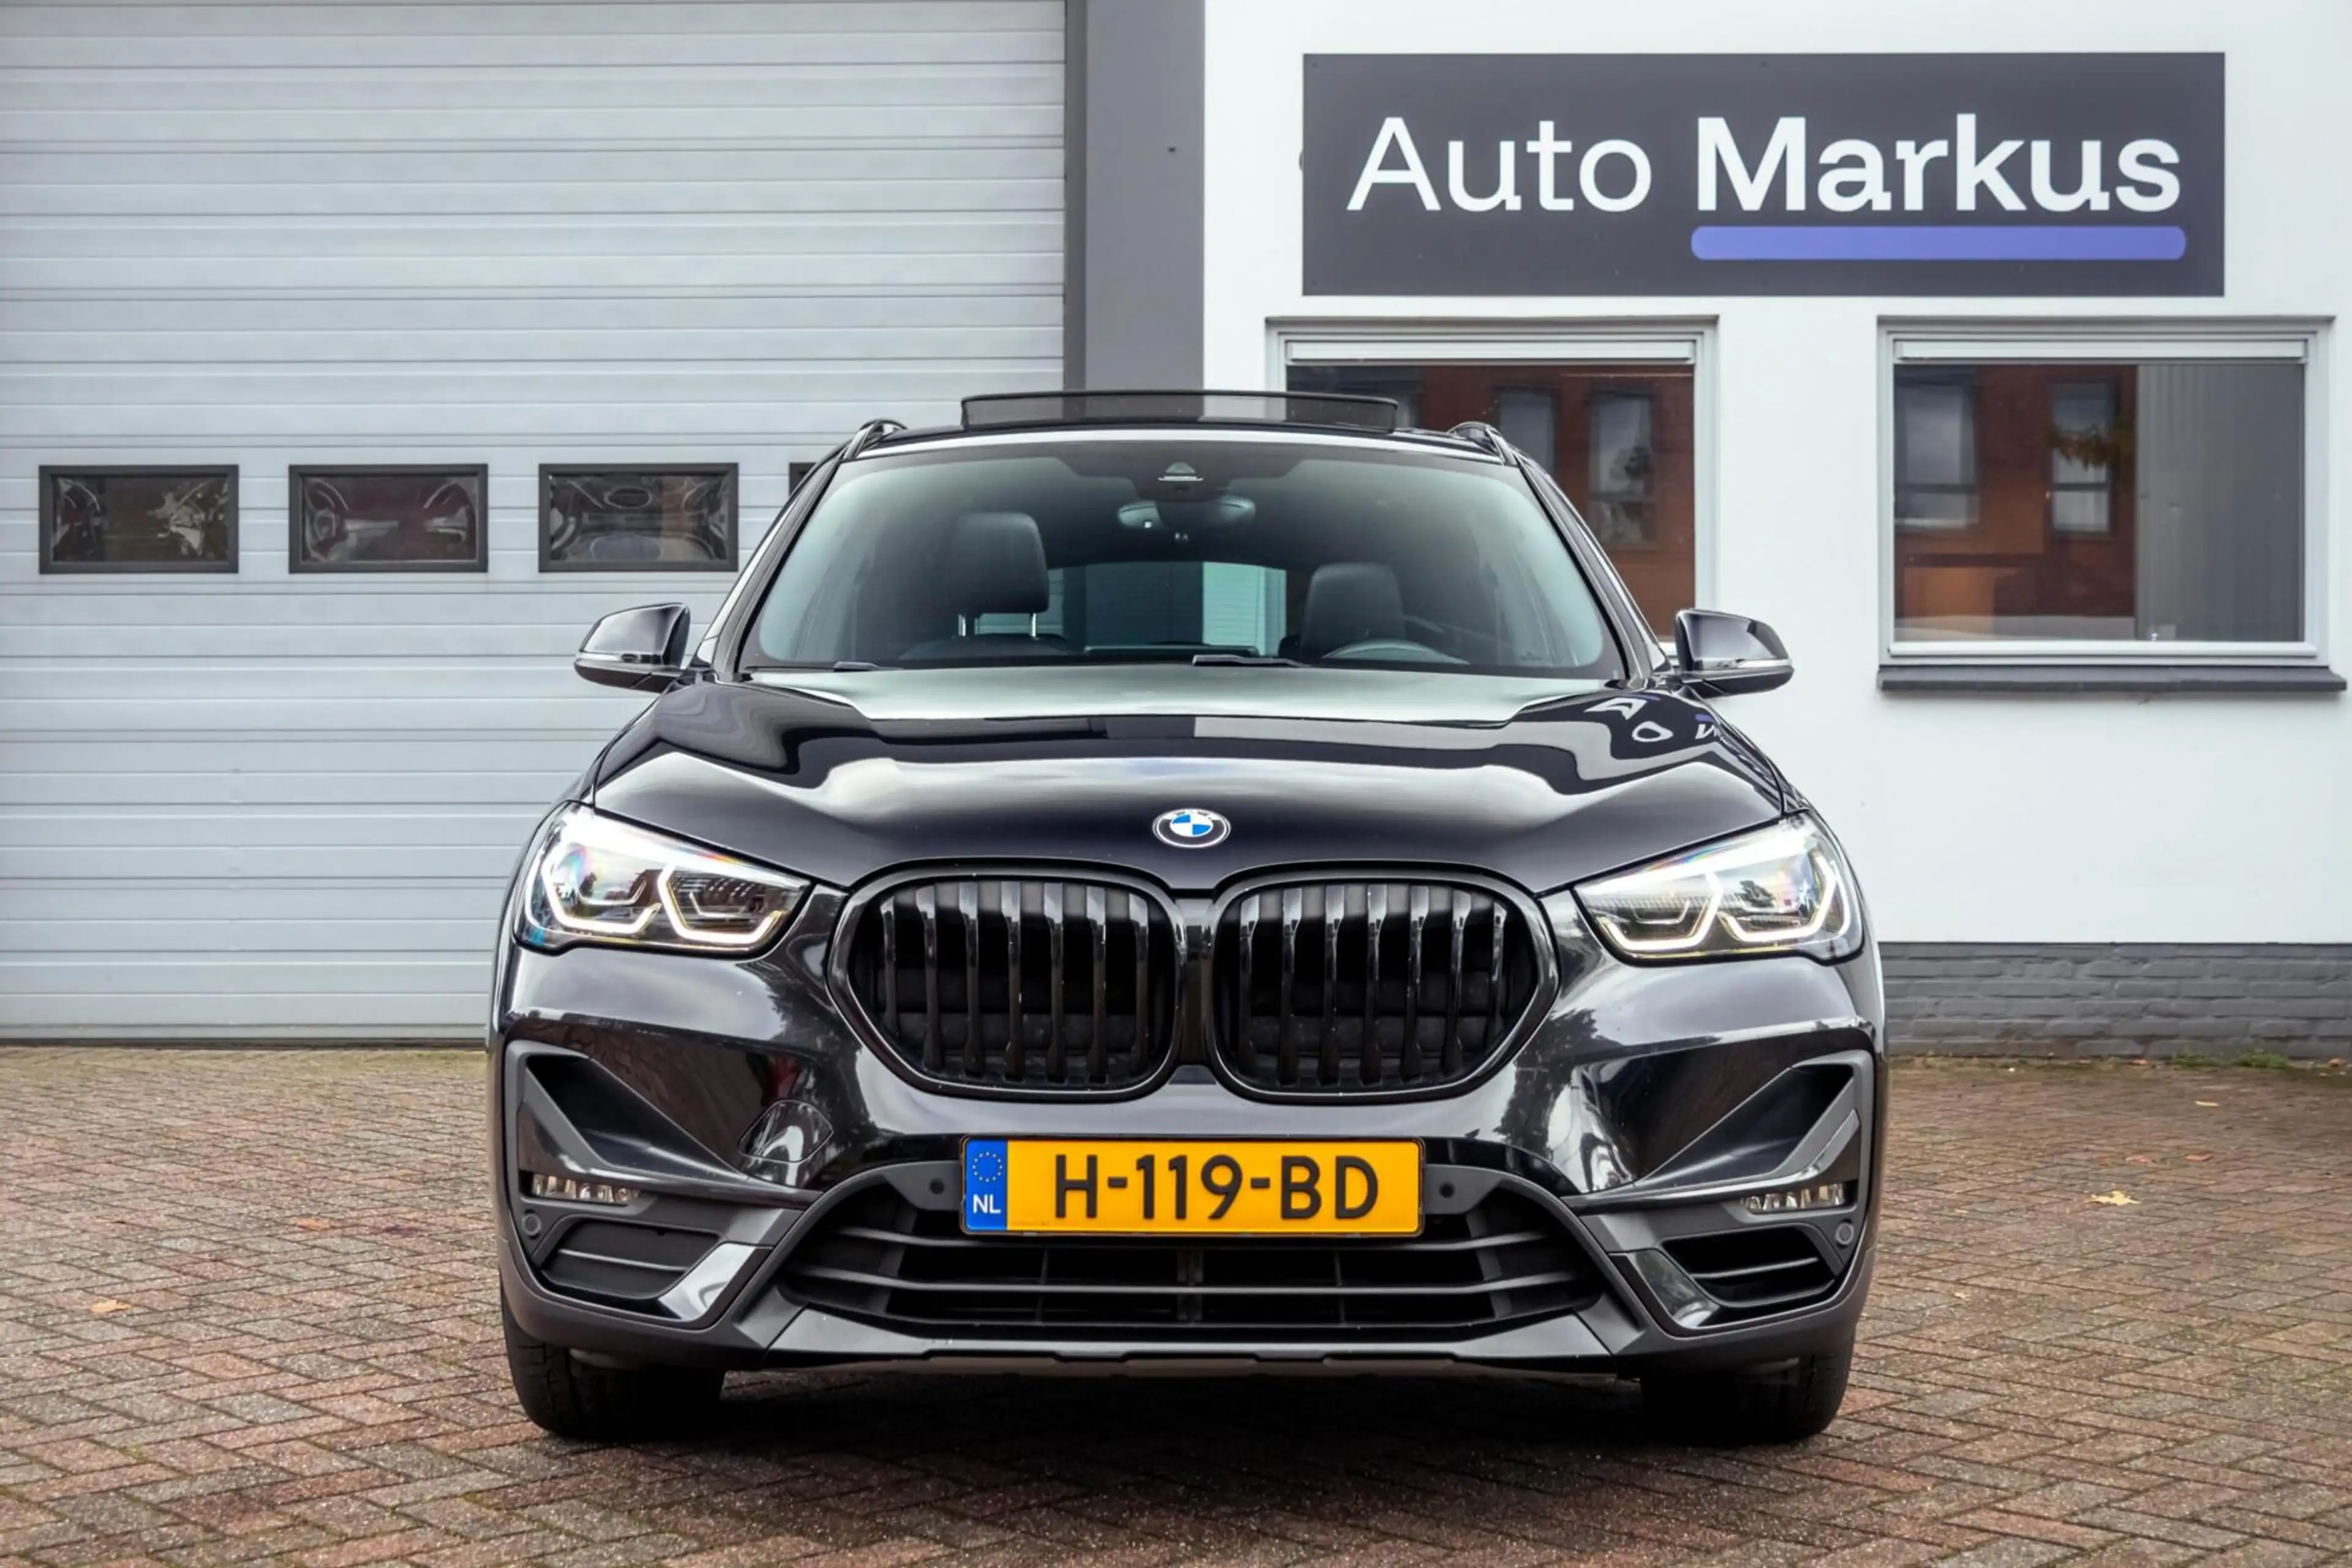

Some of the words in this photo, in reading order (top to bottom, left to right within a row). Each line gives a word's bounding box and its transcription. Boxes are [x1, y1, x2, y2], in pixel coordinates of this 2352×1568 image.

[1346, 116, 1653, 212] Auto
[1697, 113, 2181, 212] Markus
[973, 1194, 1001, 1214] NL
[1055, 1154, 1378, 1219] H-119-BD
